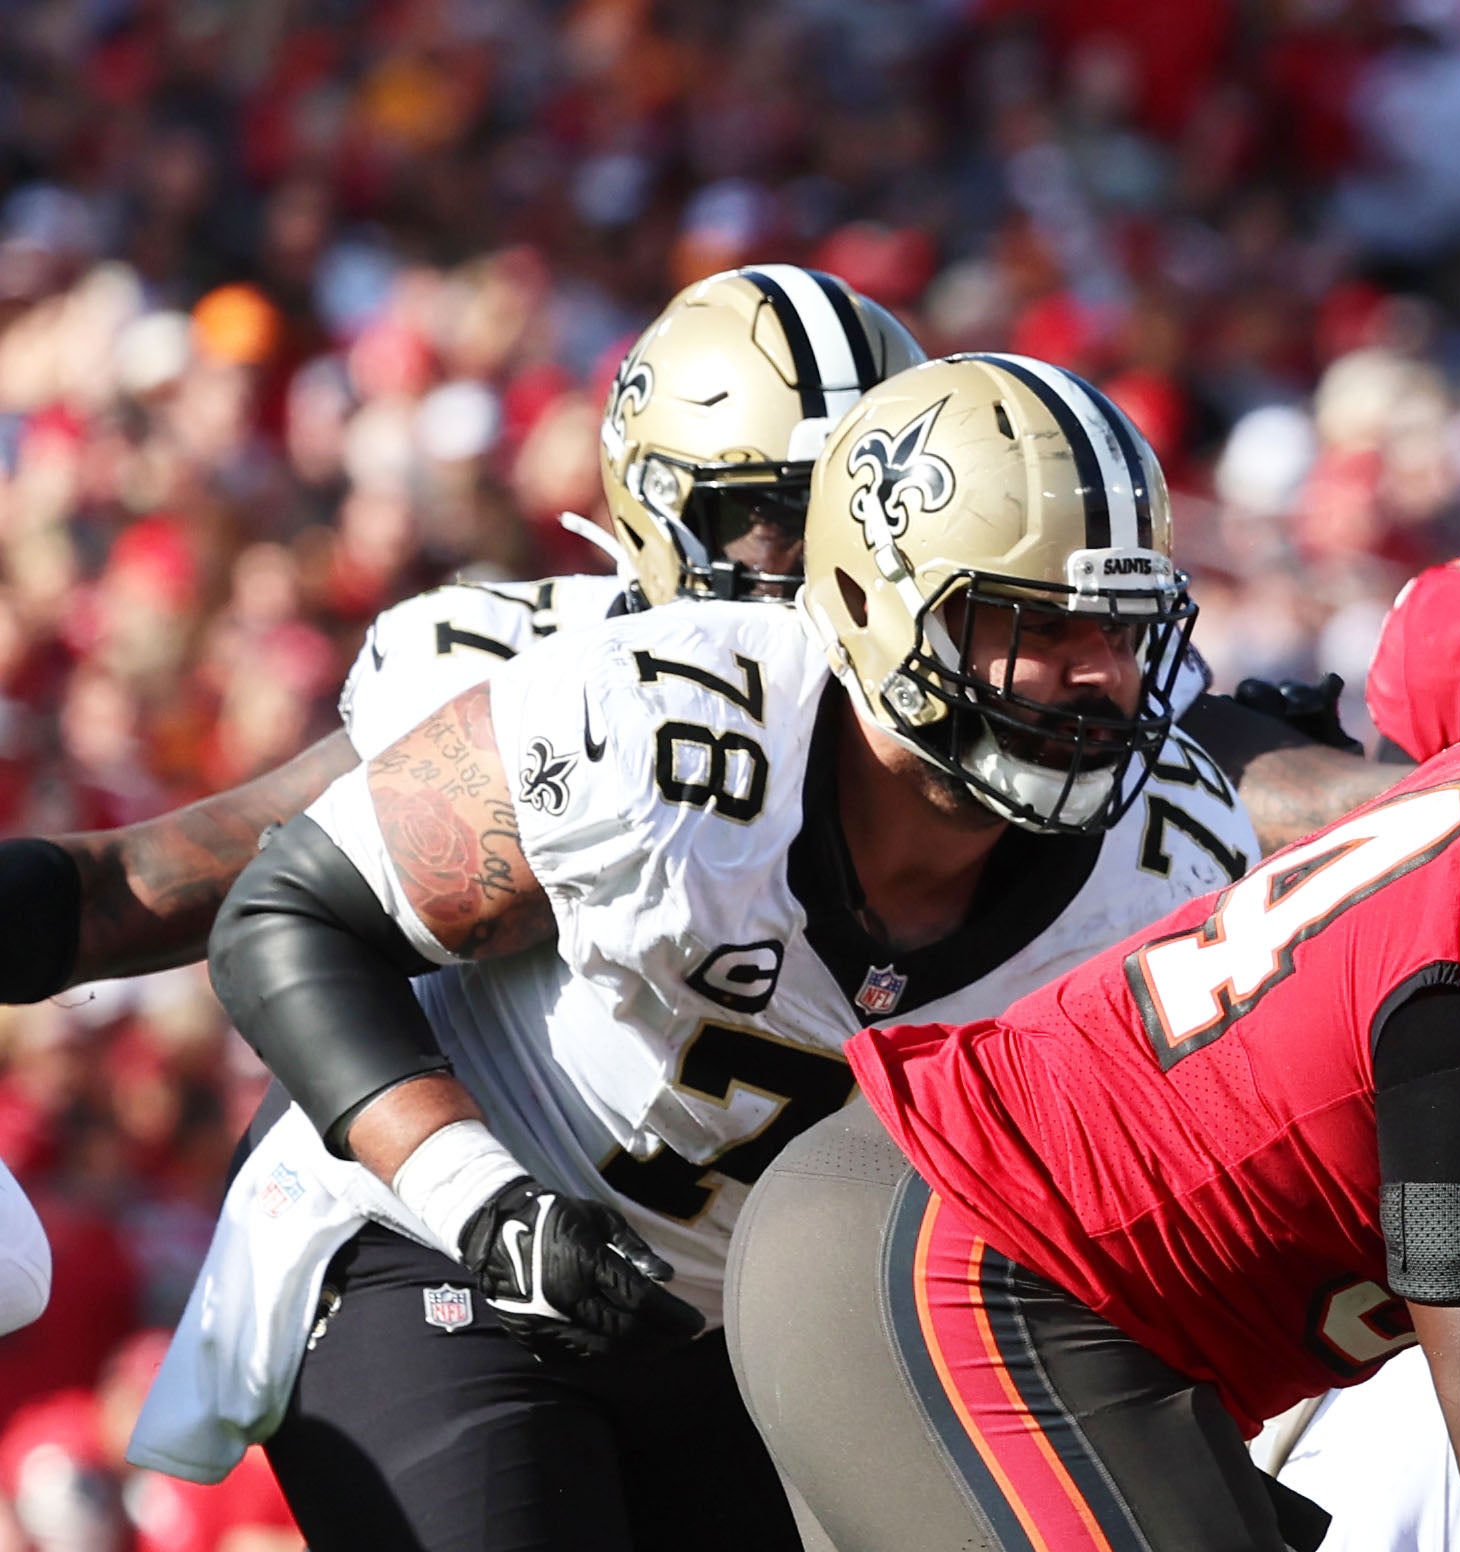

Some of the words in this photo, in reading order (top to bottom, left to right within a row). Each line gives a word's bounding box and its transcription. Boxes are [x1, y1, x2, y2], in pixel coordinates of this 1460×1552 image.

[1104, 558, 1152, 575] SAINTS
[631, 650, 769, 825] 78
[703, 947, 778, 998] C
